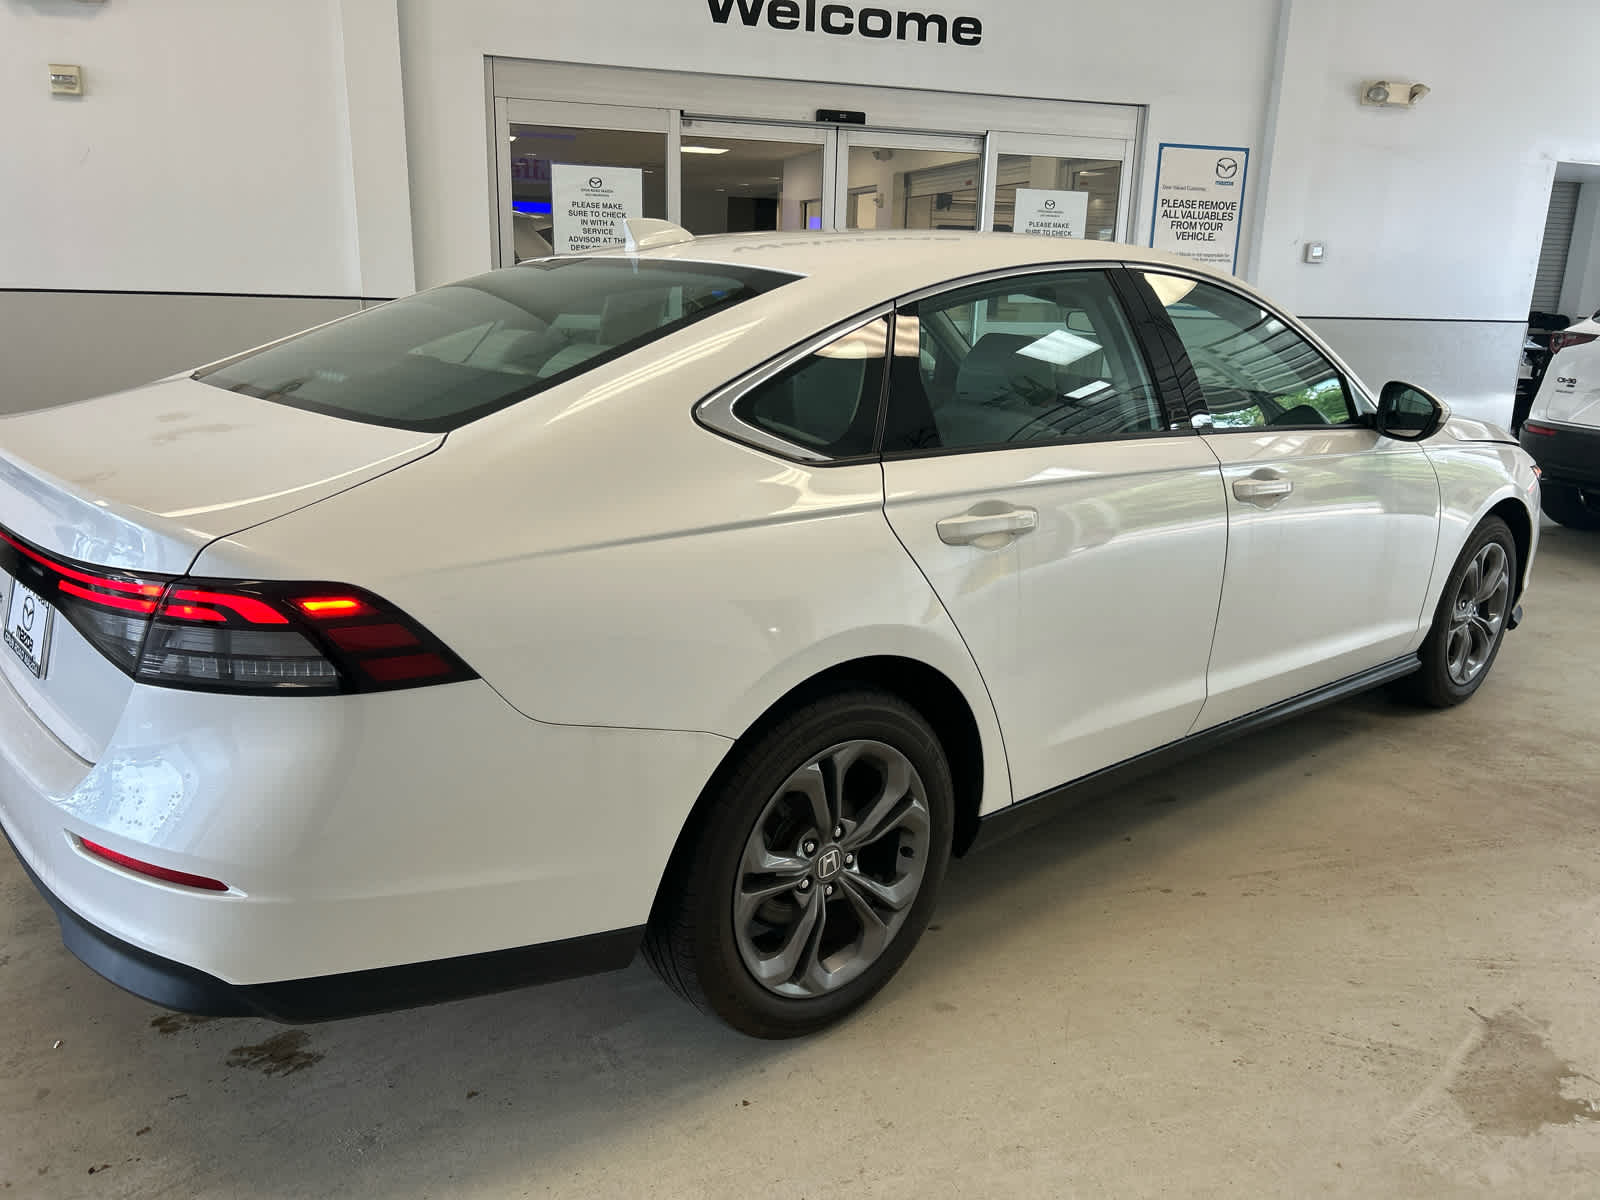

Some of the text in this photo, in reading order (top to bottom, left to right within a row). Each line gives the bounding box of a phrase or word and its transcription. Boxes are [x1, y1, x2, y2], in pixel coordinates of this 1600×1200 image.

[705, 0, 983, 46] Welcome
[572, 201, 600, 209] PLEASE
[1161, 199, 1237, 211] PLEASE REMOVE
[1162, 210, 1234, 221] ALL VALUABLES
[1170, 220, 1223, 231] FROM YOUR
[1176, 231, 1216, 241] VEHICLE.
